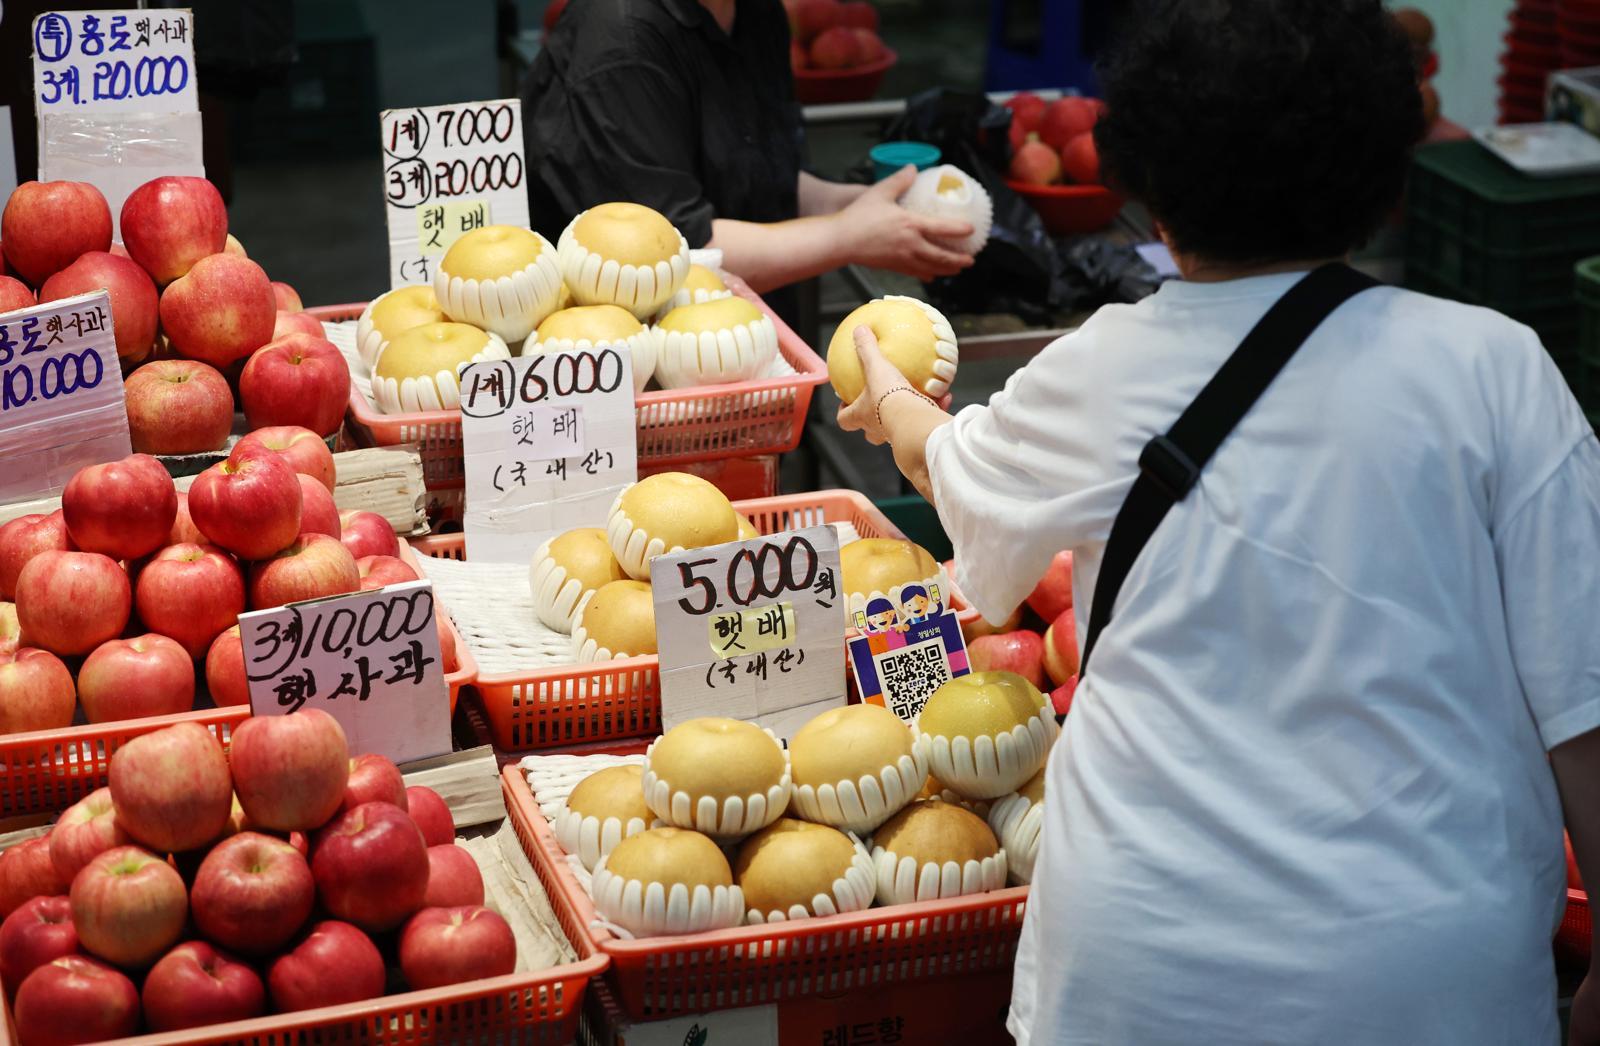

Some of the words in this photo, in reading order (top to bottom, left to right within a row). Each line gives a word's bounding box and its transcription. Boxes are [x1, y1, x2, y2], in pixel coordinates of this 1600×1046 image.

[40, 14, 65, 58] 특
[80, 15, 131, 55] 홍로
[822, 1015, 905, 1046] 레드향
